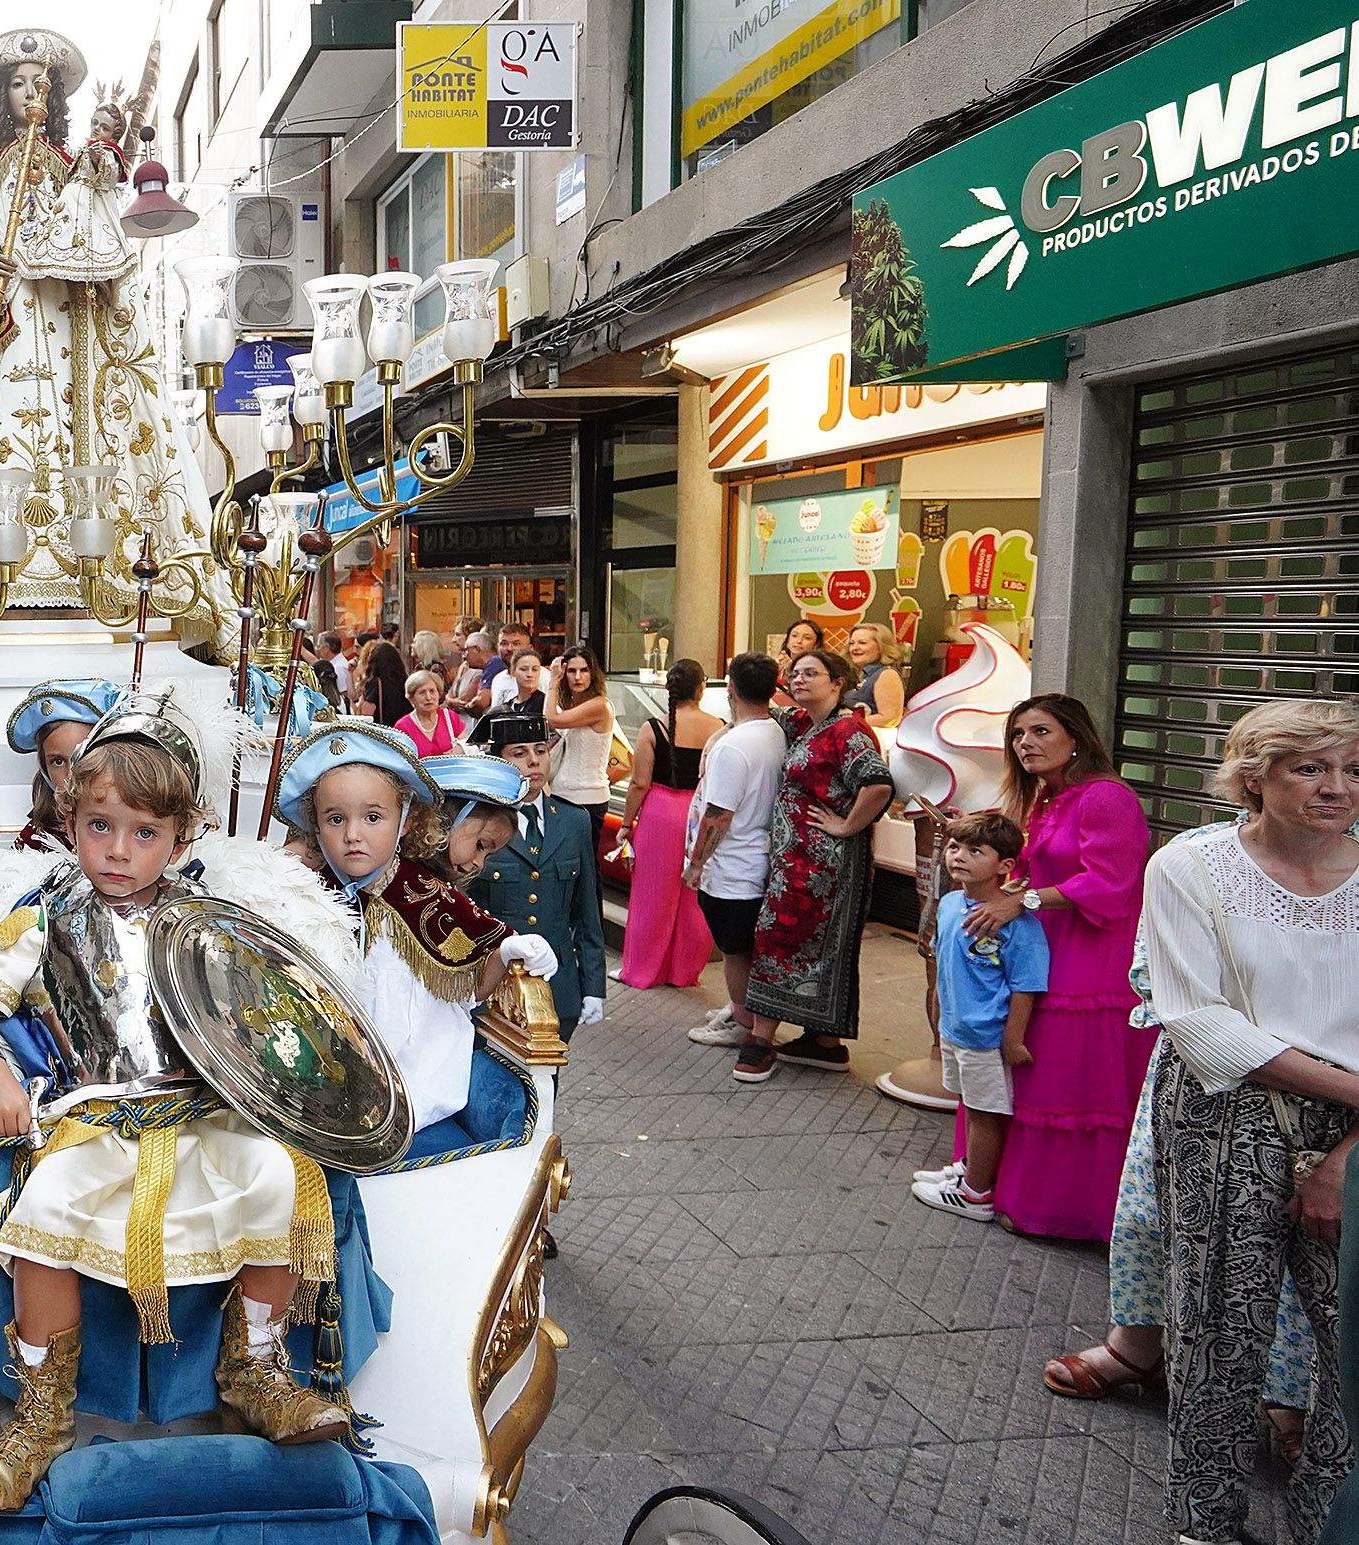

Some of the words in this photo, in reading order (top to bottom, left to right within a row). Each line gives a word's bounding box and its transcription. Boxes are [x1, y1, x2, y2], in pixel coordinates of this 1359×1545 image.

[411, 72, 476, 87] PONTE
[411, 89, 476, 102] HABITAT
[407, 108, 479, 119] INMOBILIARIA
[500, 104, 560, 127] DAC
[1020, 19, 1359, 233] CBWE
[1041, 196, 1168, 257] PRODUCTOS
[1173, 141, 1320, 212] DERIVADOS
